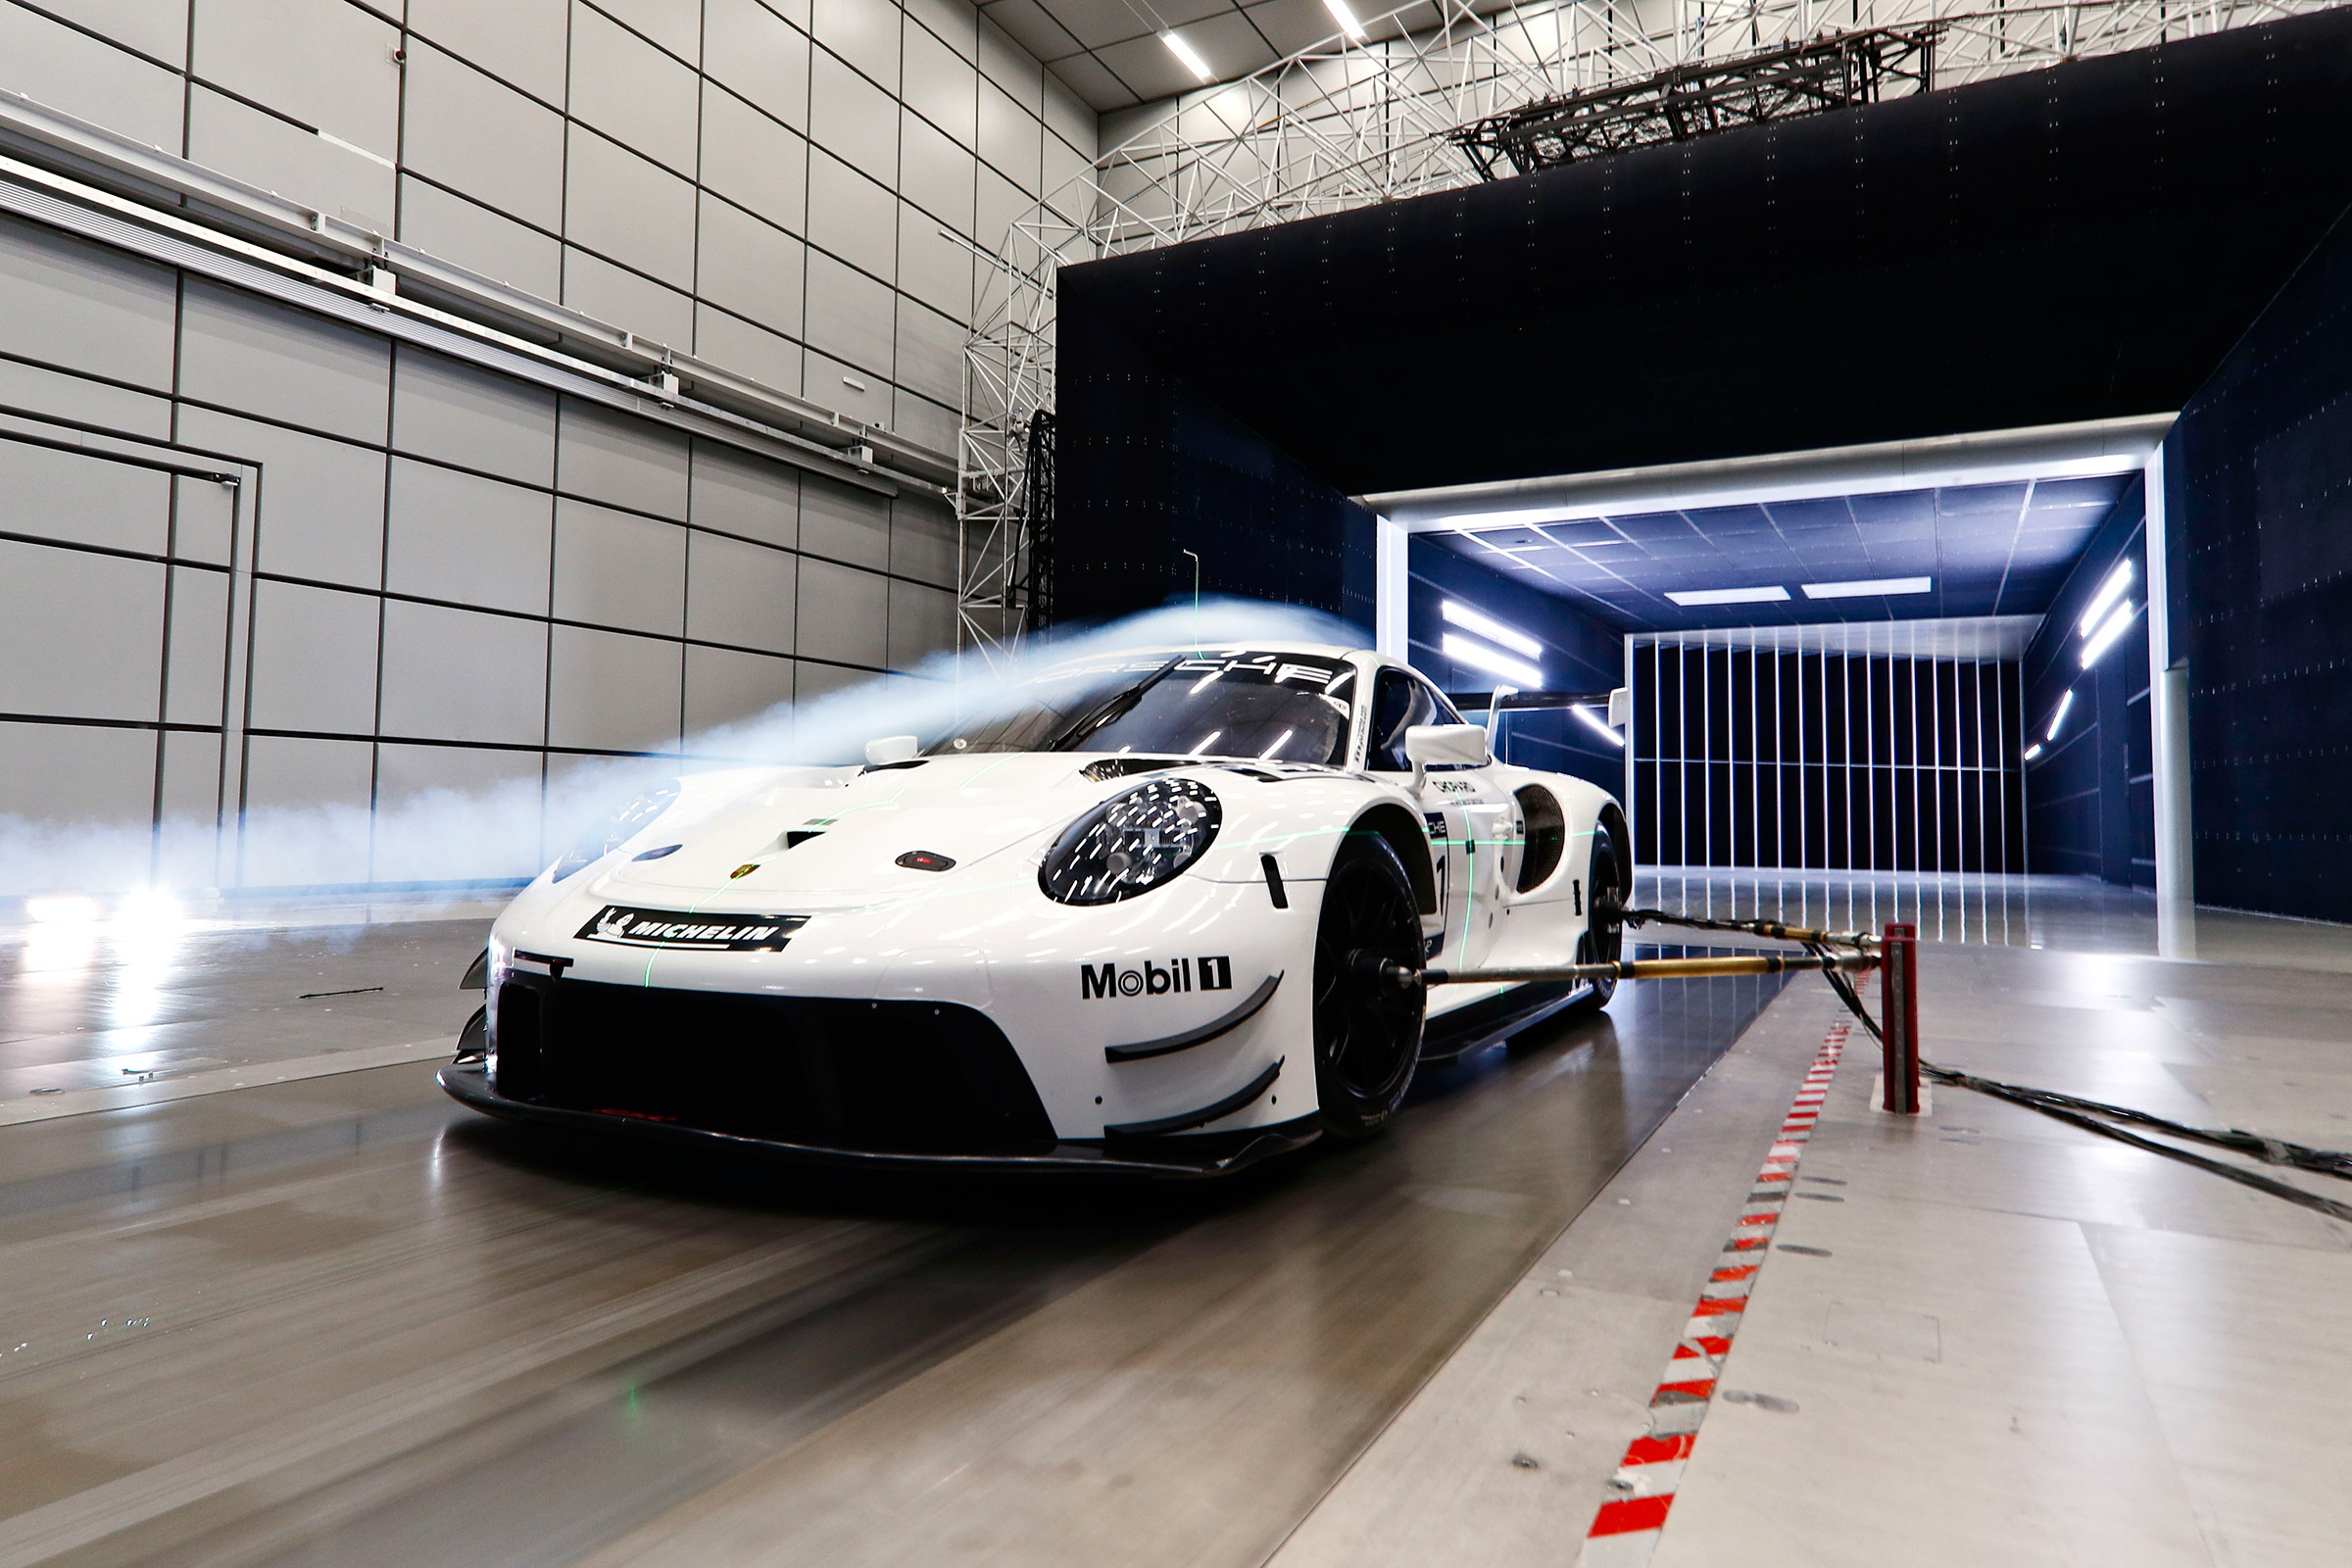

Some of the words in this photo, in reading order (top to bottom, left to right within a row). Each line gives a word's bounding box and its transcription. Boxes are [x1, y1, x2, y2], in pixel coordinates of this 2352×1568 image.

[1032, 660, 1333, 684] ORSCHE
[628, 920, 779, 942] MICHELIN
[1080, 957, 1192, 1001] Mobil
